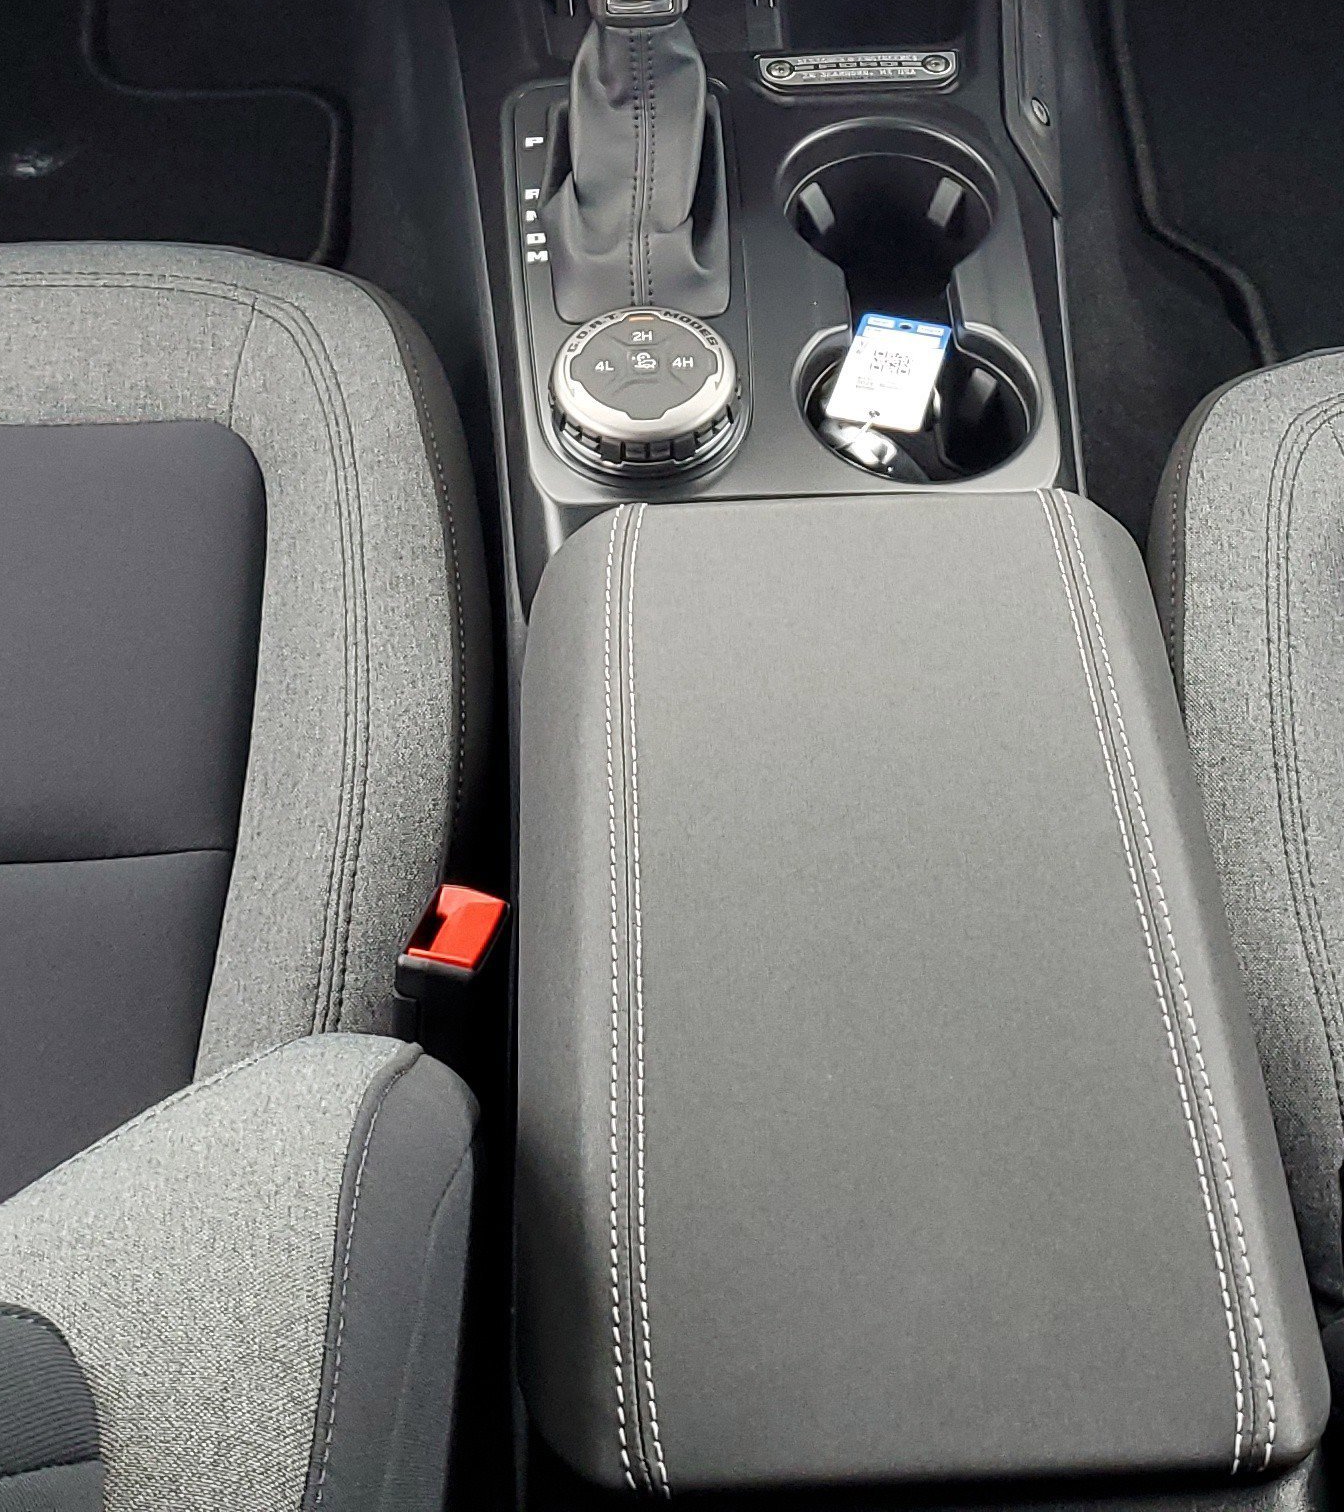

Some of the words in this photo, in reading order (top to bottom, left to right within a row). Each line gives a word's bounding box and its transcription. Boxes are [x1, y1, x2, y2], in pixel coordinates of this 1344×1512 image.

[524, 136, 544, 148] P
[526, 232, 547, 245] D
[526, 250, 549, 263] M
[663, 311, 719, 347] MODES
[631, 330, 653, 342] 2H
[594, 360, 615, 372] 4L
[672, 356, 694, 369] 4H
